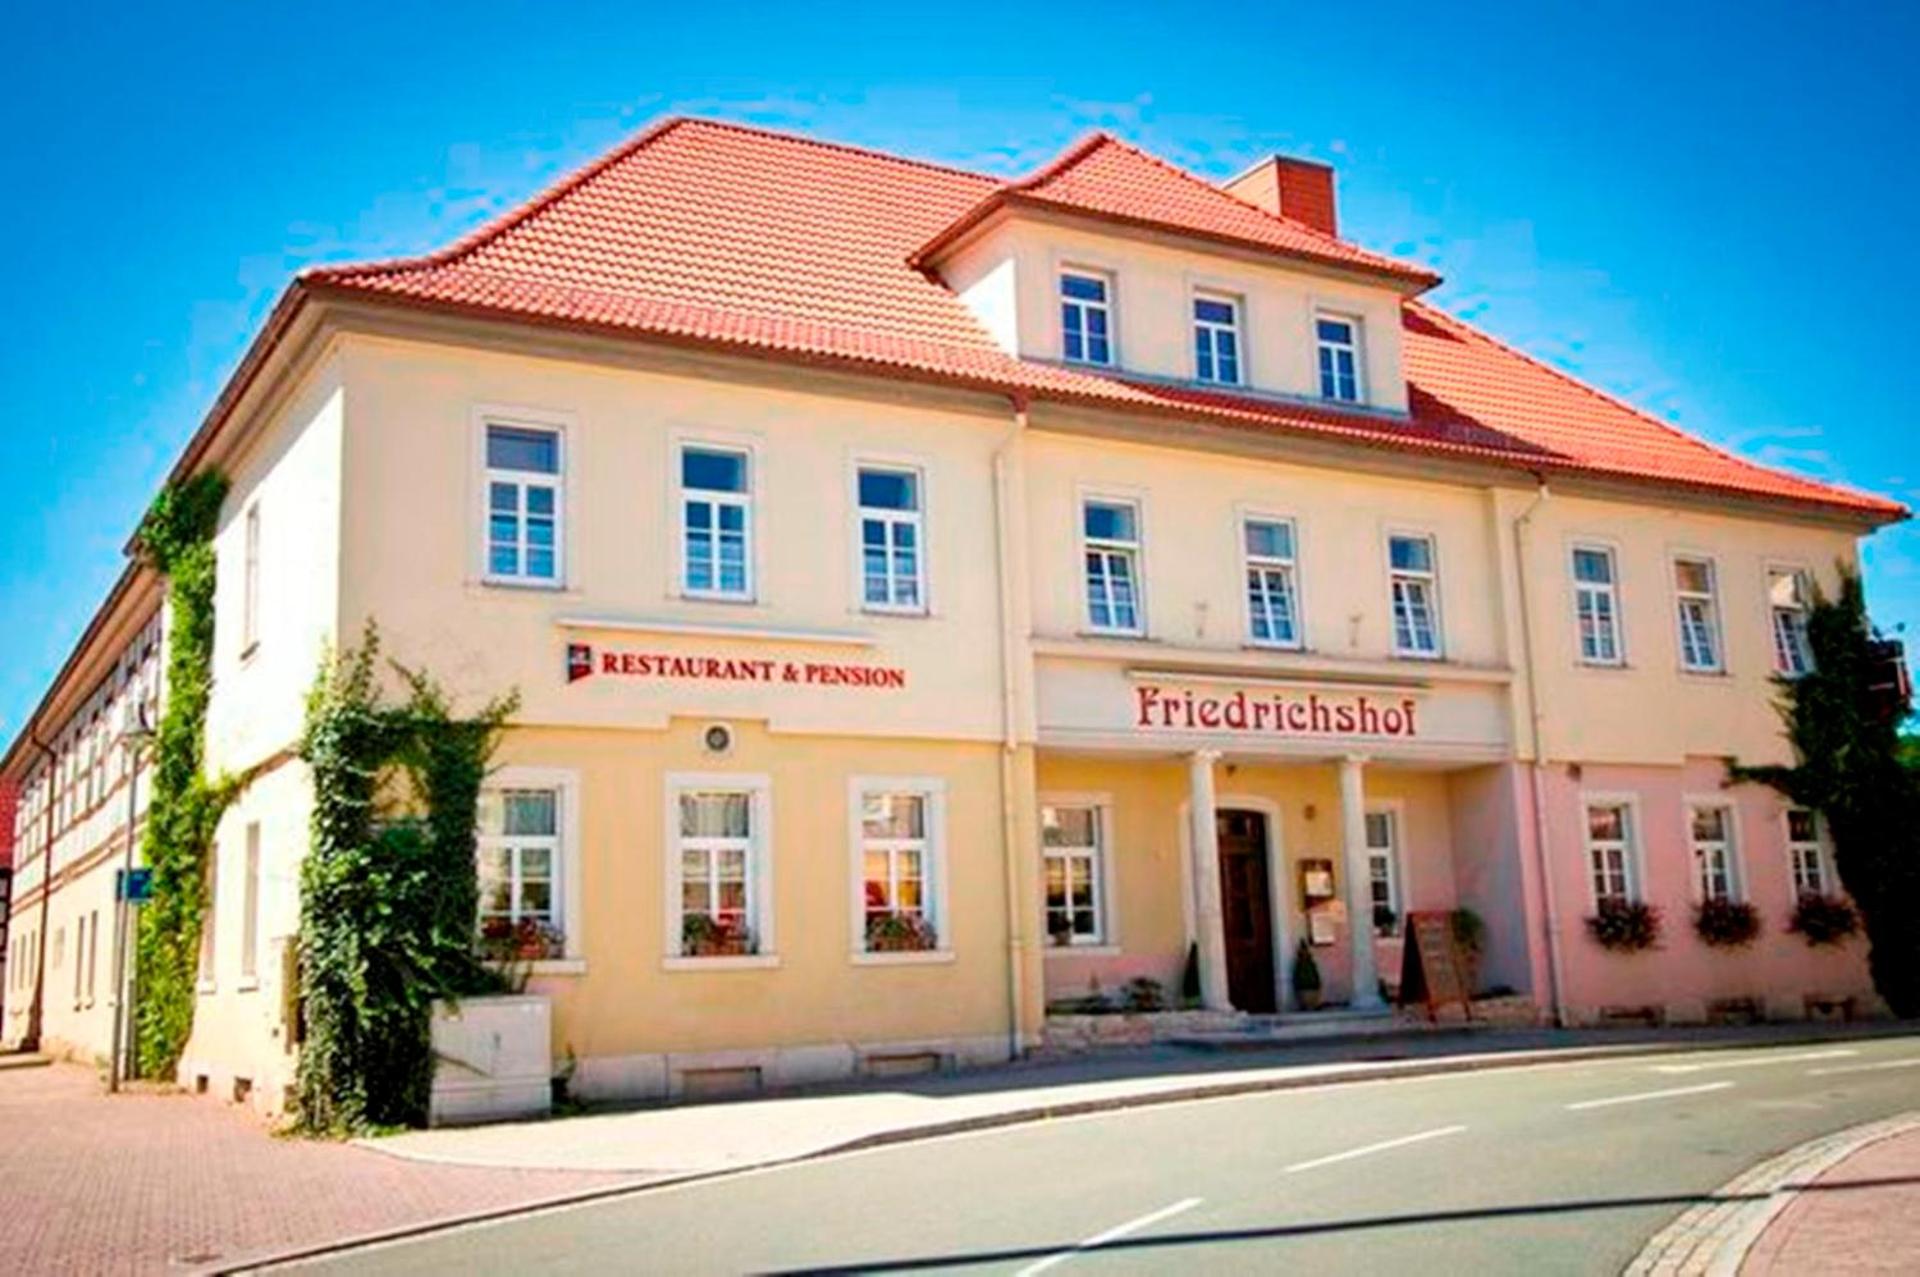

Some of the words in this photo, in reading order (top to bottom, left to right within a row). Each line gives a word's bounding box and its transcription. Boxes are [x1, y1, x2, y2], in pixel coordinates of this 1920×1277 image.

[602, 653, 775, 682] RESTAURANT
[781, 663, 800, 683] &
[806, 663, 905, 688] PENSION
[1137, 686, 1416, 736] Friedrichshof
